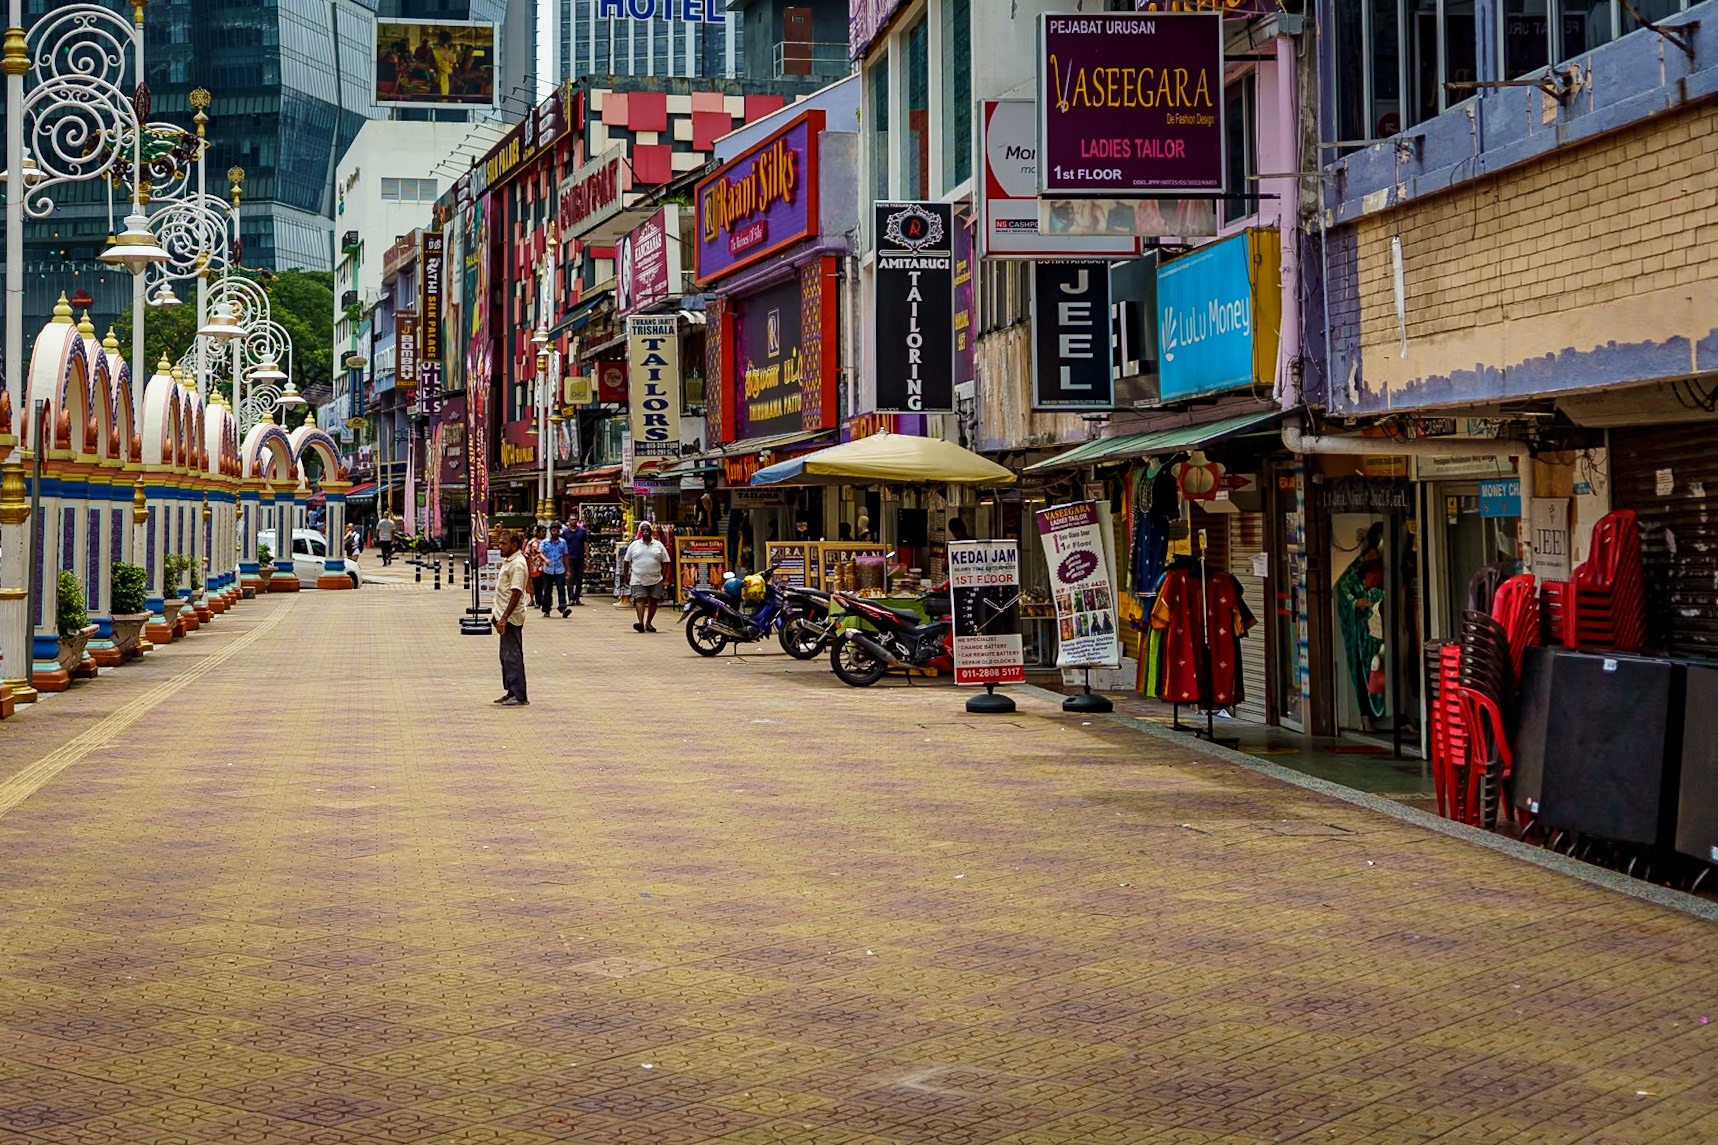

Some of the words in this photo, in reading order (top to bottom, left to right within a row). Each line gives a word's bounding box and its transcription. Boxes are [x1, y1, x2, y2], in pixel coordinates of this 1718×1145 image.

[598, 0, 725, 24] HOTEL
[1050, 20, 1103, 34] PEJABAT
[1106, 20, 1156, 35] URUSAN
[1050, 54, 1213, 113] VASEEGARA
[1166, 113, 1175, 125] De
[1175, 113, 1196, 126] Fashion
[1196, 113, 1214, 127] Design
[1081, 139, 1131, 159] LADIES
[1134, 139, 1186, 159] TAILOR
[1053, 165, 1075, 181] 1st
[1077, 168, 1122, 181] FLOOR
[717, 161, 756, 232] Raani
[758, 139, 795, 213] Silks
[879, 258, 950, 269] AMITARUCI
[426, 257, 441, 294] RATHI
[427, 296, 437, 318] SILK
[1208, 297, 1251, 337] Money
[632, 326, 675, 335] TRISHALA
[1058, 269, 1093, 390] JEEL
[427, 320, 437, 358] PALACE
[906, 271, 923, 411] TAILORING
[400, 334, 414, 380] BOMBAY
[640, 337, 670, 441] TAILORS
[1481, 485, 1506, 497] MONEY
[1508, 485, 1520, 494] CH
[1044, 504, 1091, 521] VASEEGARA
[1068, 513, 1088, 522] TAILOR
[785, 547, 804, 556] RA
[951, 550, 988, 564] KEDAI
[991, 549, 1016, 563] JAM
[955, 576, 973, 585] 1ST
[977, 574, 1014, 583] FLOOR
[1001, 667, 1020, 676] 5117
